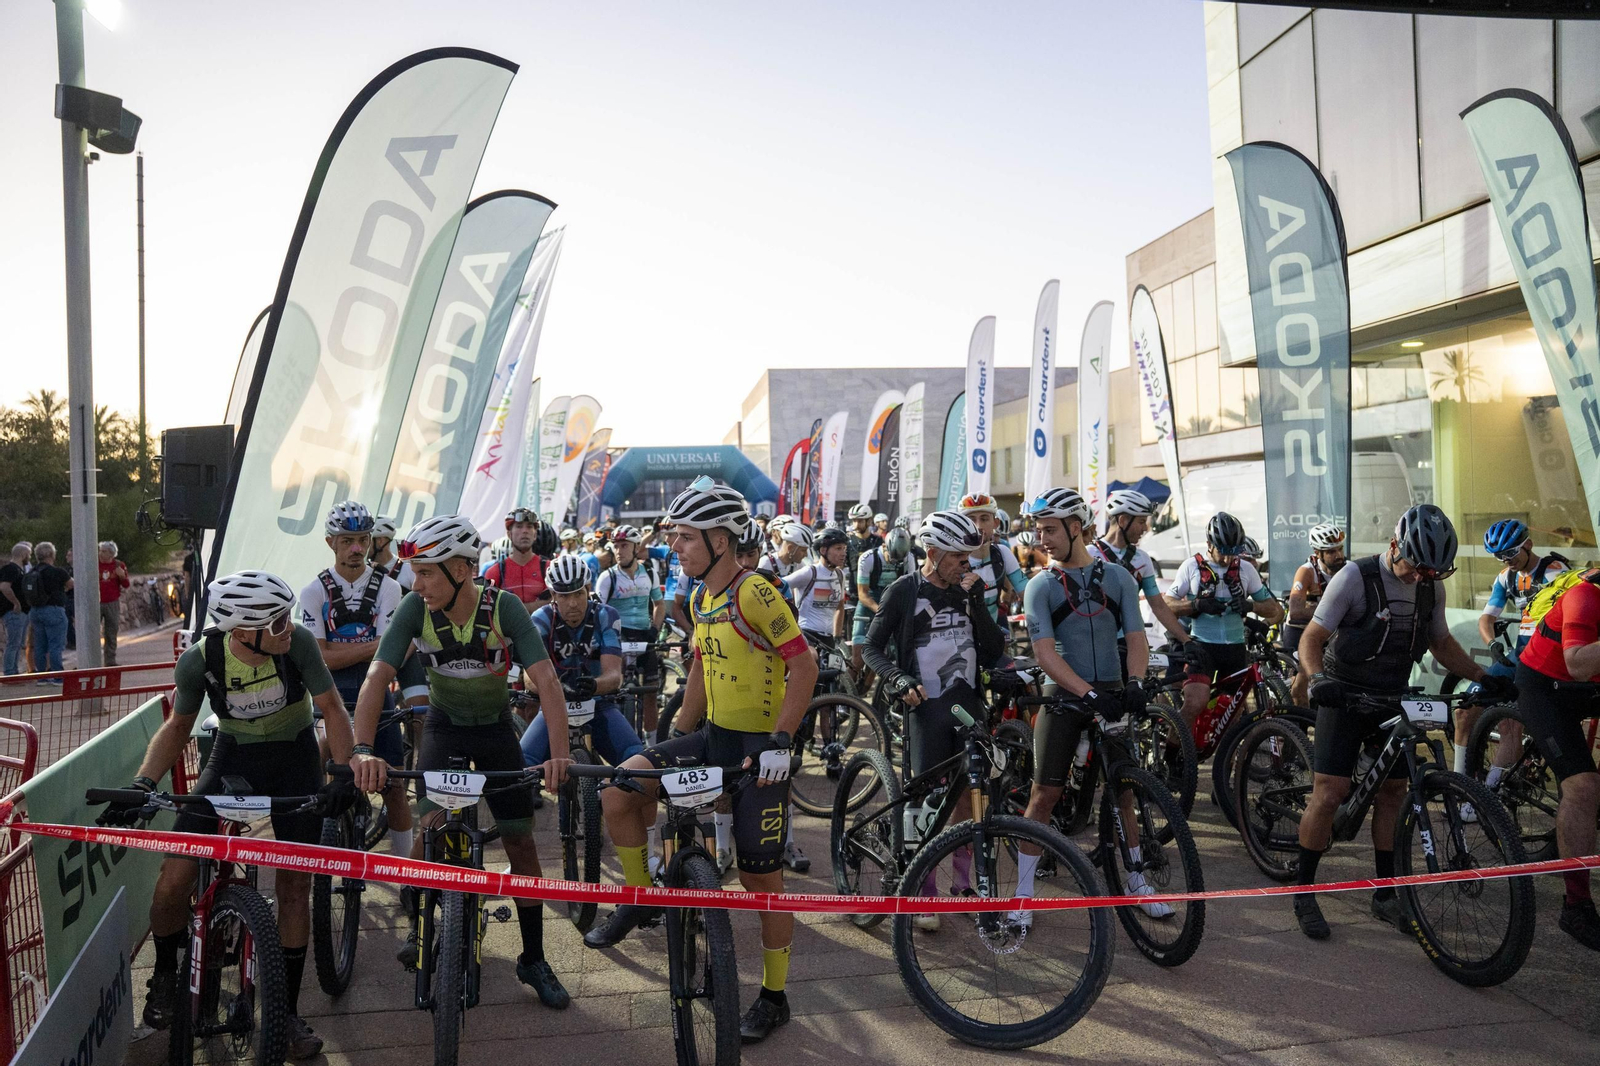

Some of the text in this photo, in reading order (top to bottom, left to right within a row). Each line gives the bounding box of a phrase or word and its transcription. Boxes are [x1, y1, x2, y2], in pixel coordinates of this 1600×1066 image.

[1038, 326, 1050, 423] Cleardent
[976, 359, 988, 444] Cleardent
[647, 452, 722, 464] UNIVERSAE
[887, 447, 900, 503] HEMÓN
[931, 612, 971, 629] BH
[762, 654, 773, 718] FASTER
[1416, 702, 1434, 713] 29
[441, 773, 468, 786] 101
[678, 769, 709, 786] 483
[685, 783, 707, 793] DANIEL
[1346, 736, 1395, 819] SCOTT
[1420, 829, 1435, 857] FOX
[237, 849, 351, 872] www.titandesert.com
[374, 864, 488, 885] www.titandesert.com
[977, 875, 990, 898] FO
[1410, 919, 1440, 959] MAXXIS
